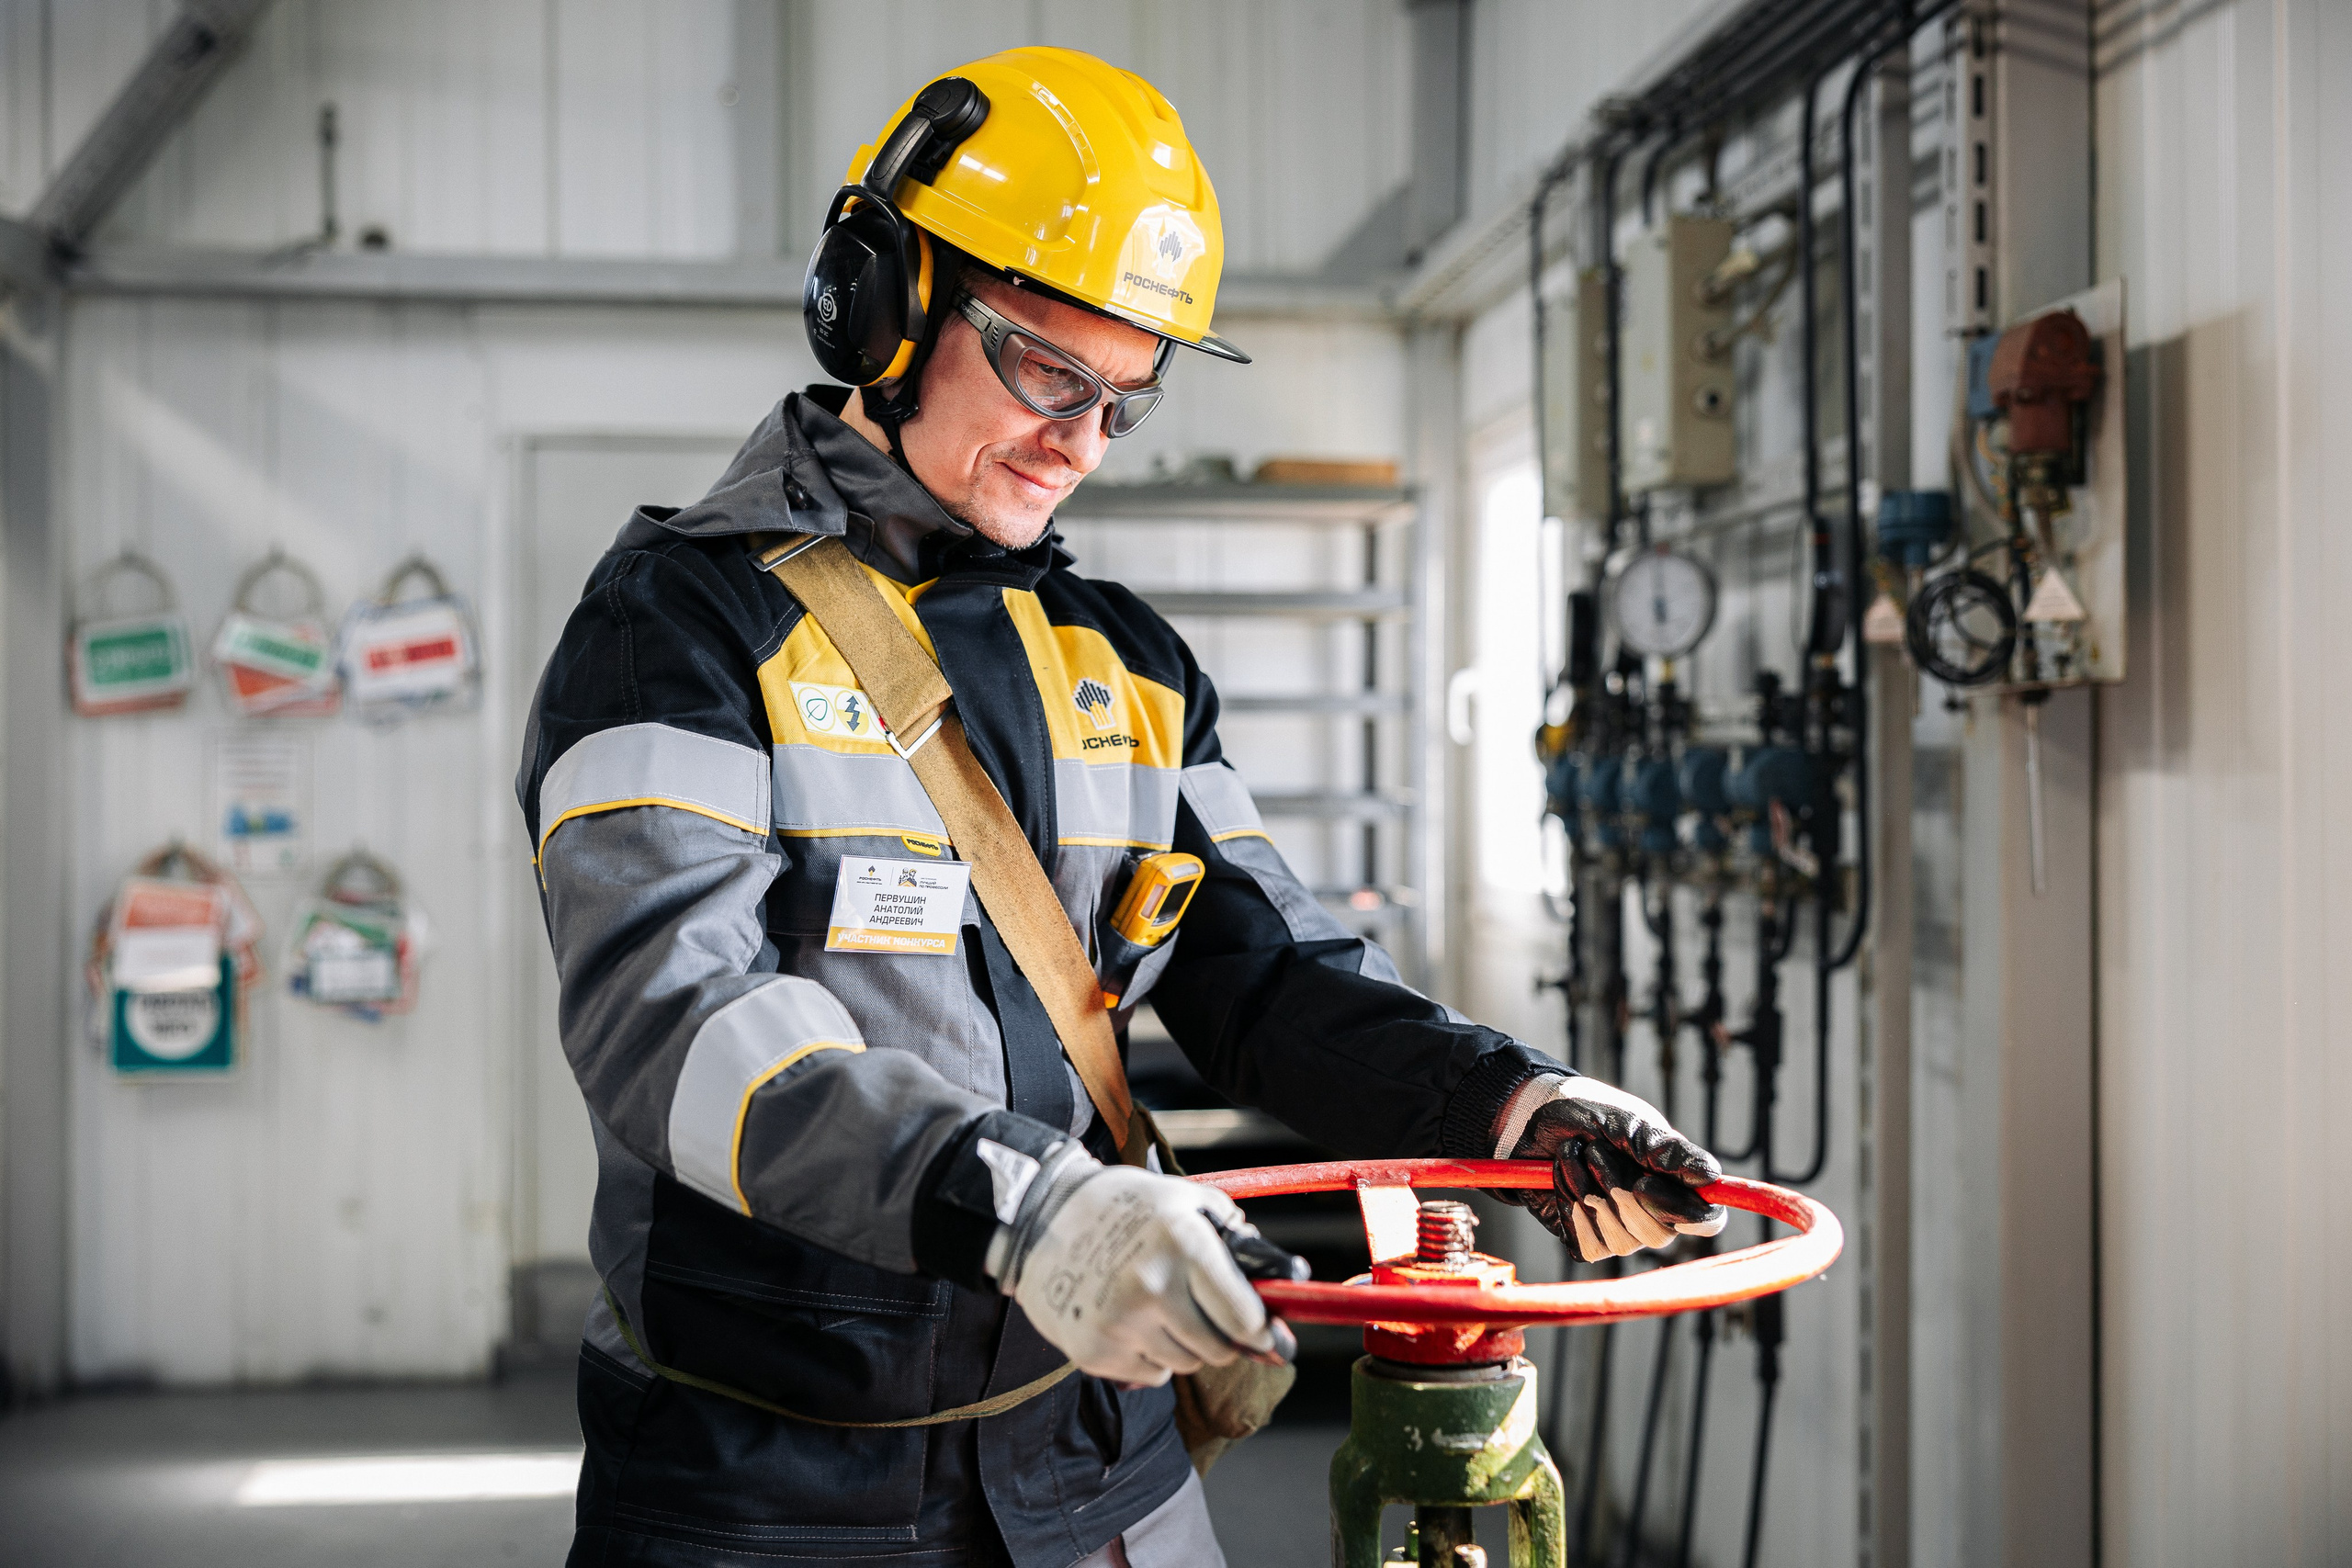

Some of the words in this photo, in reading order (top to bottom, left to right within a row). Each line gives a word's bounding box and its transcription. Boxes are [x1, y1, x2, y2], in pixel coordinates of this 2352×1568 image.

[1124, 272, 1193, 305] РОСНЕФТЬ
[875, 893, 926, 904] ПЕРВУШИН
[874, 905, 923, 915] АНАТОЛИЙ
[869, 915, 924, 926] АНДРЕЕВИЧ
[837, 933, 891, 945] УЧАСТНИК
[893, 937, 945, 948] КОНКУРСА
